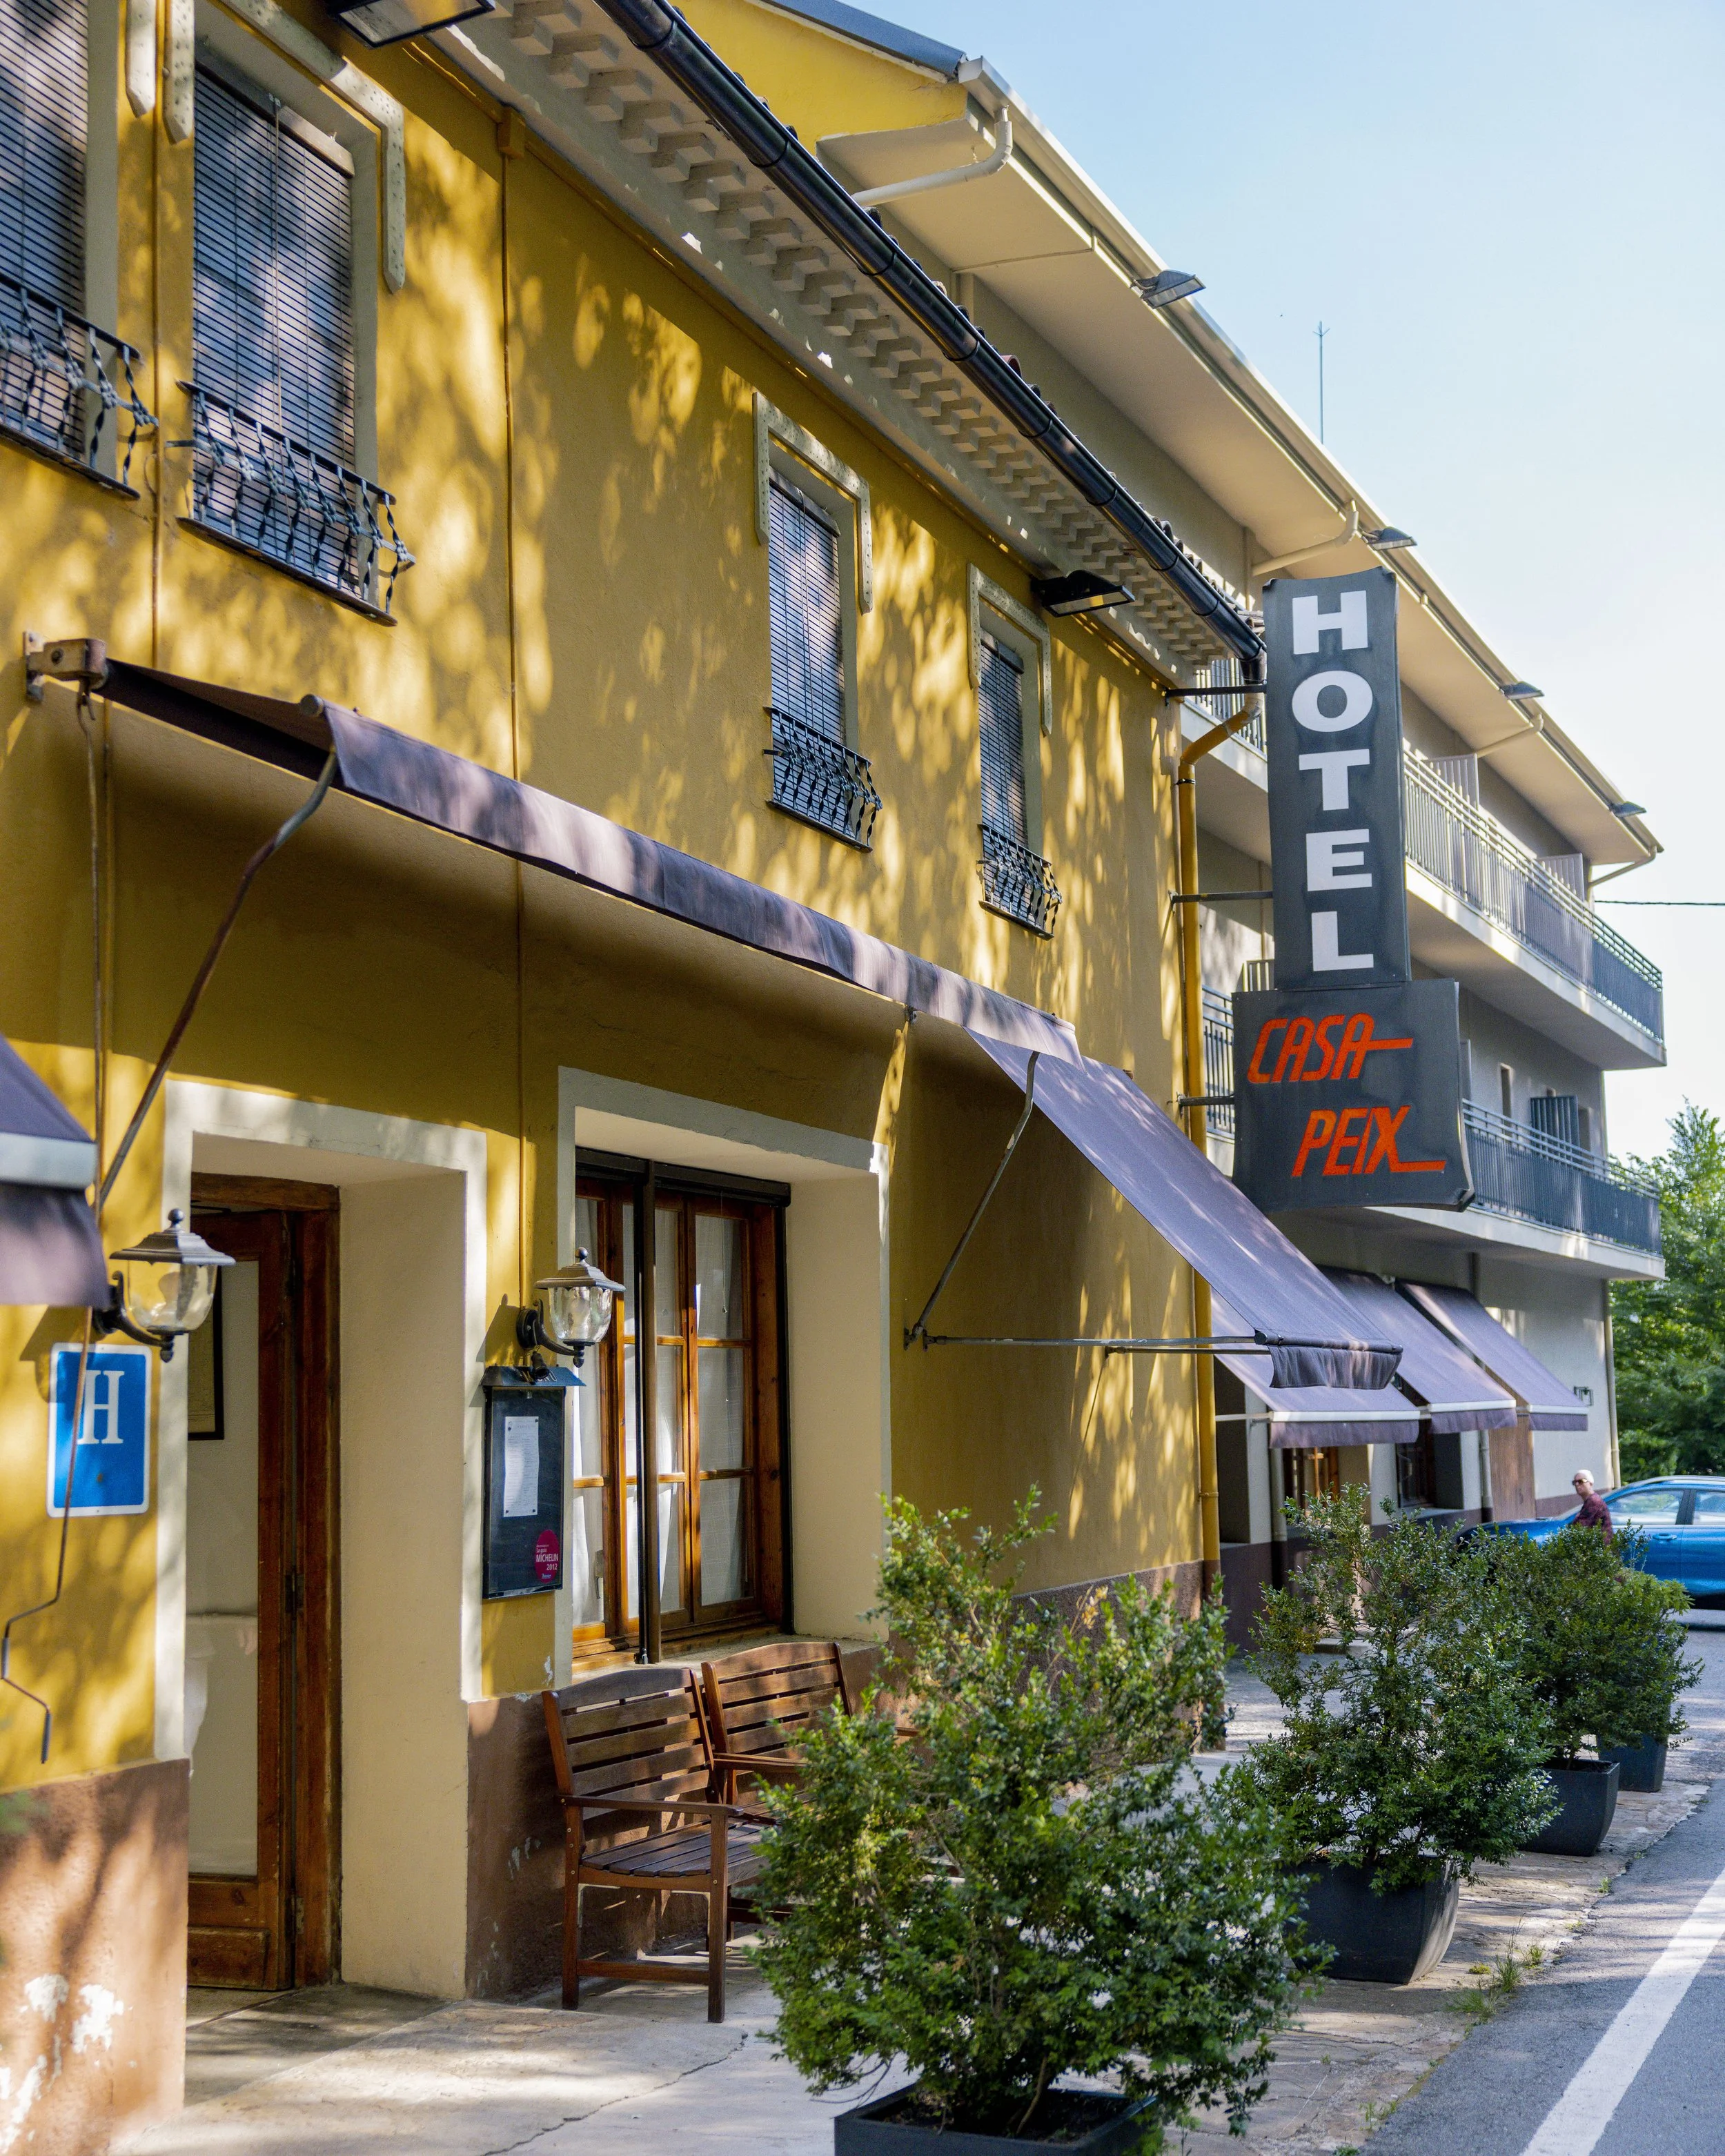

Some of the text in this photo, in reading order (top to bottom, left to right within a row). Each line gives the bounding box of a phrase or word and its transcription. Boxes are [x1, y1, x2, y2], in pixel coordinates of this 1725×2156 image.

[1292, 590, 1374, 971] HOTEL
[1248, 1012, 1413, 1084] CASA
[1292, 1105, 1446, 1178] PEIX
[77, 1370, 125, 1444] H
[536, 1553, 558, 1562] MICHELIN
